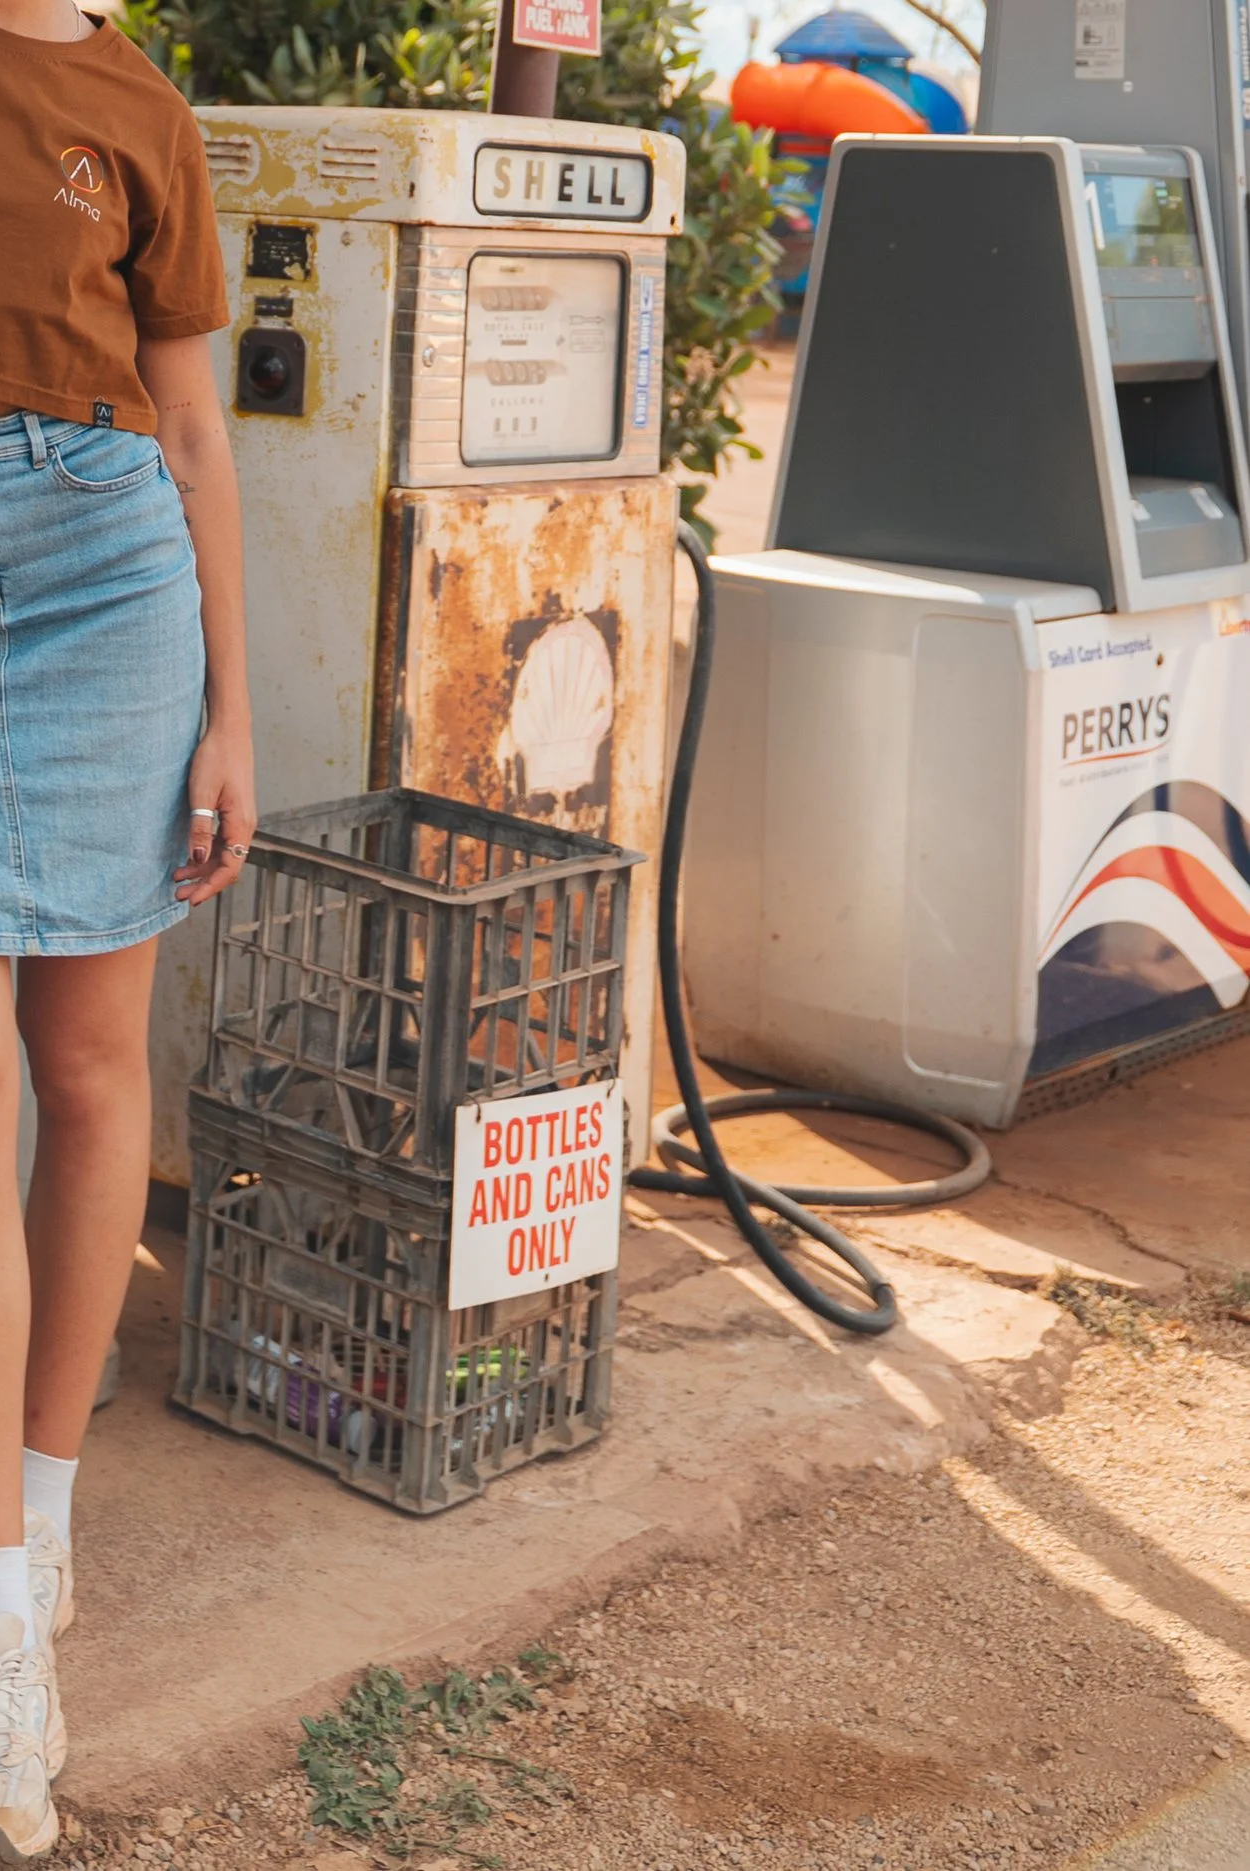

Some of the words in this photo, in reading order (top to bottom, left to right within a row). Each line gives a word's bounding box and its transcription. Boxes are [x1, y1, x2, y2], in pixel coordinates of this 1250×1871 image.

[525, 5, 554, 33] FUEL
[556, 11, 590, 38] TANK
[493, 156, 625, 206] SHELL
[1062, 694, 1171, 759] PERRYS
[483, 1101, 603, 1169] BOTTLES
[468, 1172, 532, 1228] AND
[545, 1153, 611, 1213] CANS
[507, 1216, 576, 1276] ONLY
